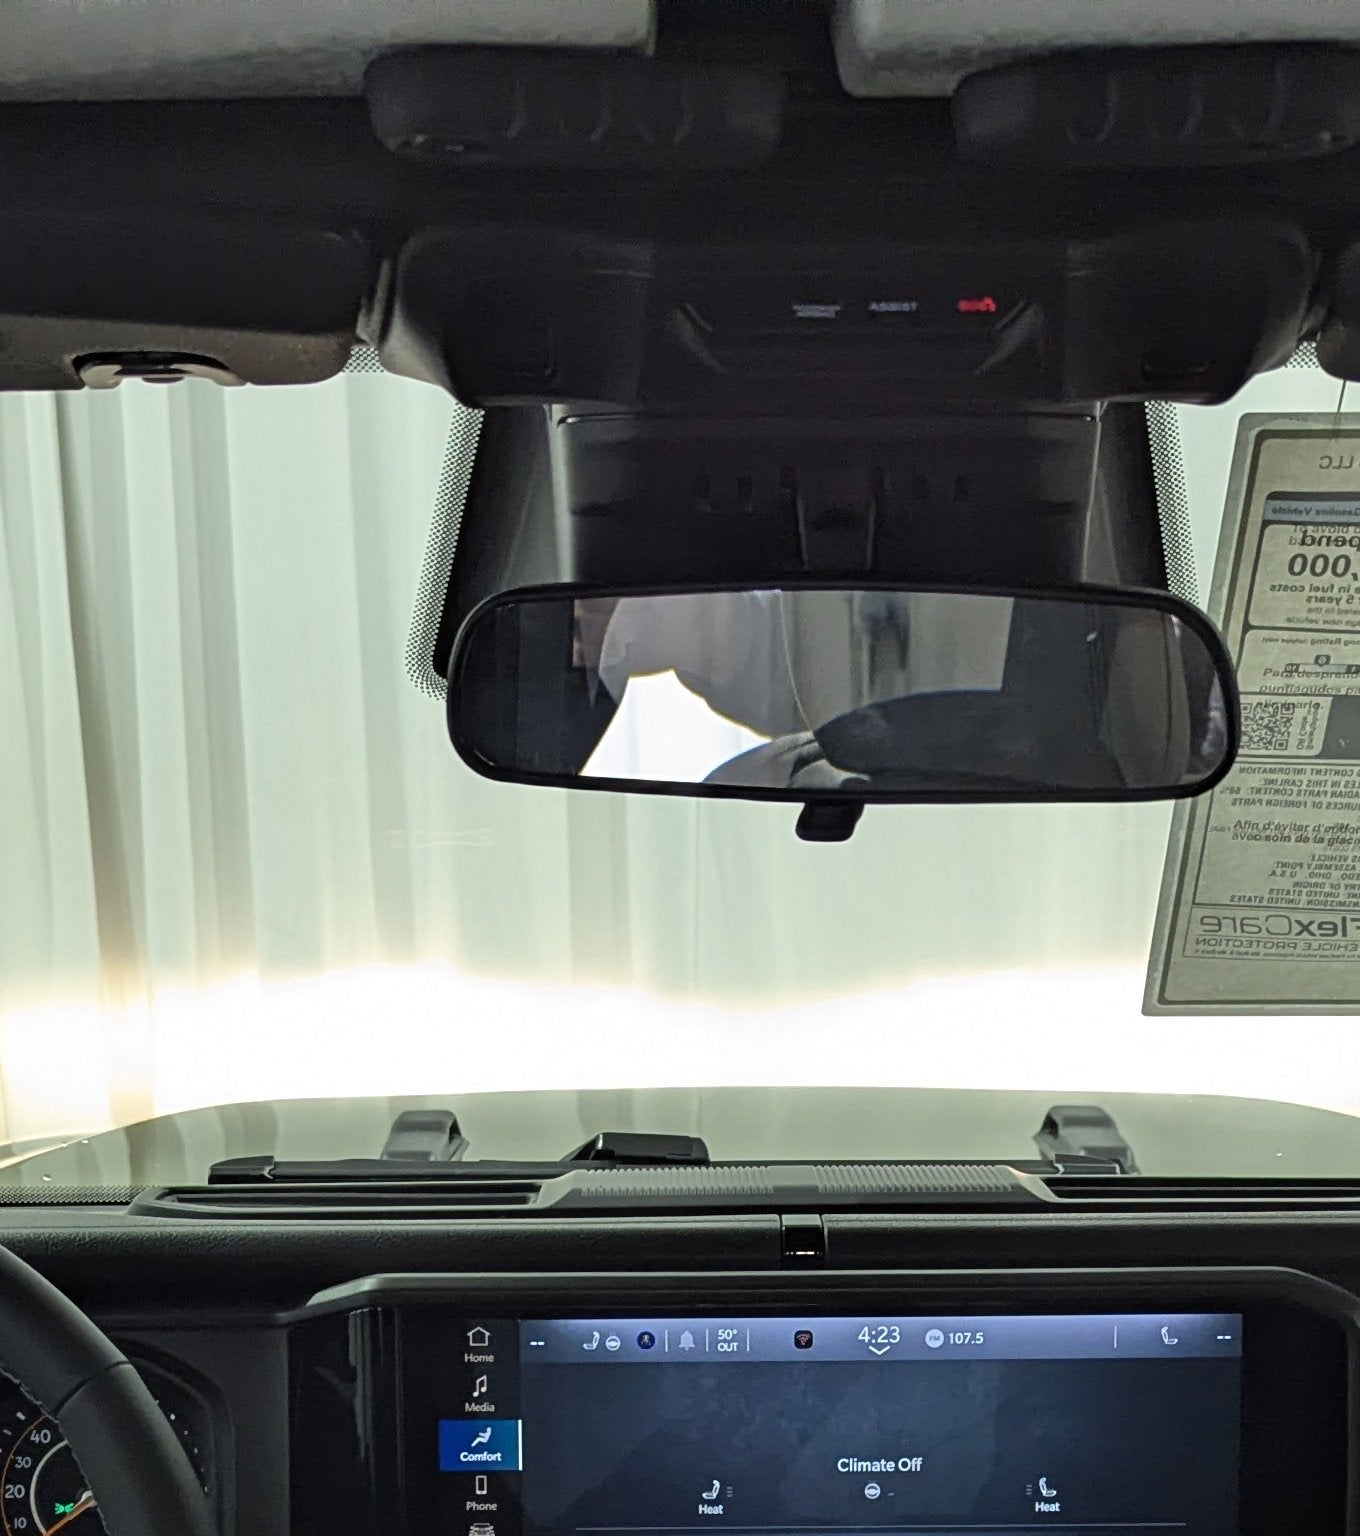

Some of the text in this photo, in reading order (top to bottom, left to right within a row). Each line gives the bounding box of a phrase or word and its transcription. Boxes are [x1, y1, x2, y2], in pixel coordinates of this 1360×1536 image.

[718, 1329, 738, 1341] 50°
[858, 1326, 900, 1343] 4:23
[948, 1332, 984, 1345] 107.5
[717, 1342, 738, 1353] OUT
[464, 1353, 494, 1363] Home
[465, 1402, 495, 1413] Media
[31, 1429, 51, 1445] 40
[14, 1455, 32, 1469] 30
[460, 1451, 502, 1462] Comfort
[837, 1457, 923, 1472] Climate Off
[5, 1484, 25, 1499] 20
[466, 1501, 497, 1511] Phone
[698, 1504, 724, 1515] Heat
[1035, 1502, 1060, 1513] Heat
[14, 1517, 27, 1529] 10
